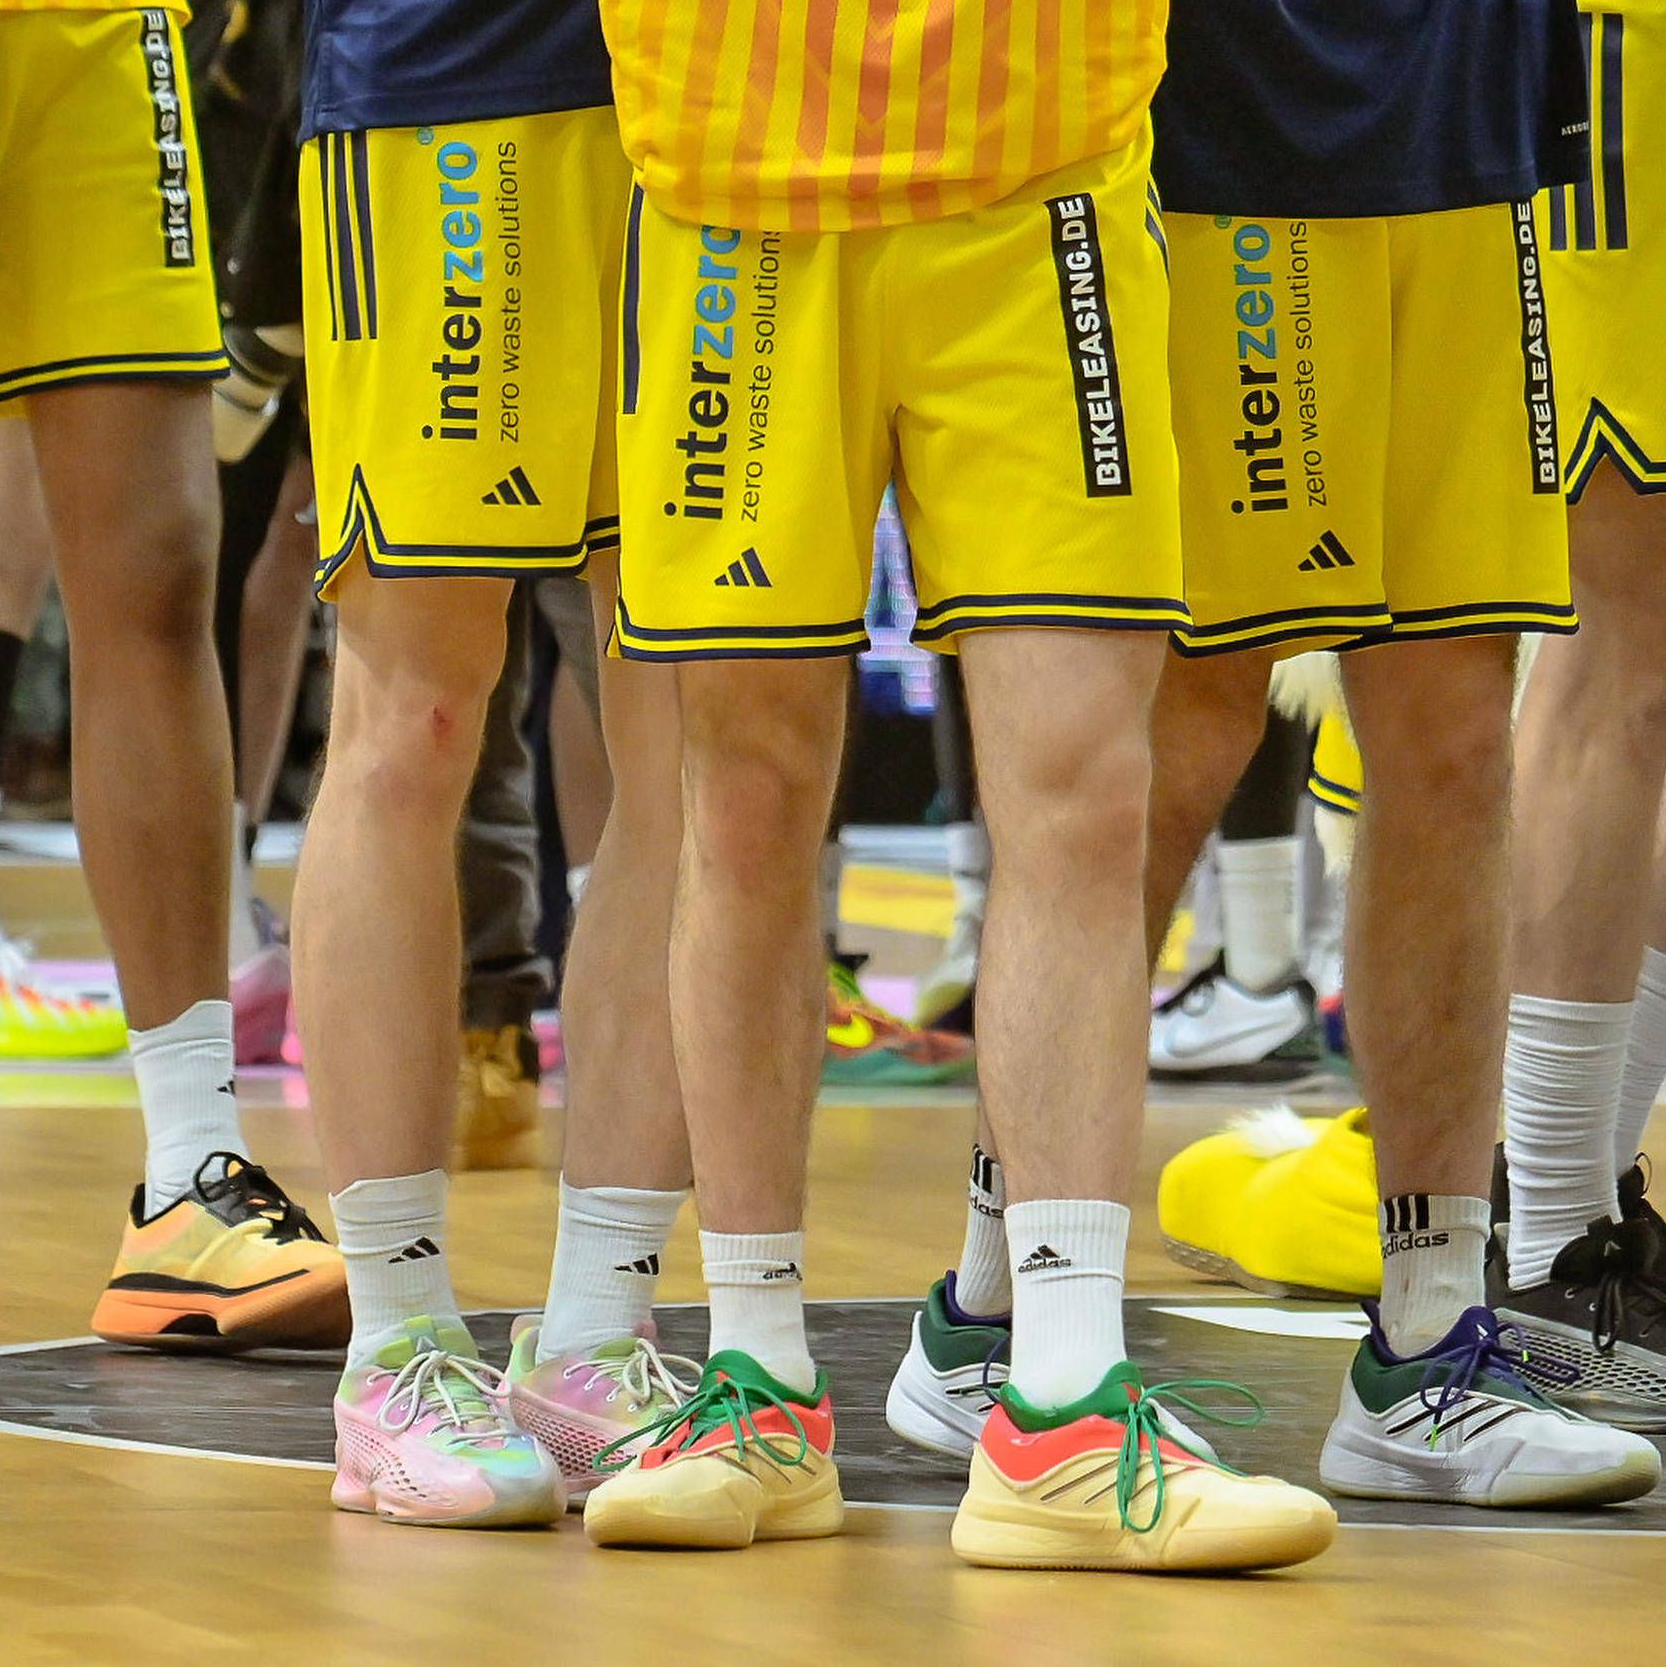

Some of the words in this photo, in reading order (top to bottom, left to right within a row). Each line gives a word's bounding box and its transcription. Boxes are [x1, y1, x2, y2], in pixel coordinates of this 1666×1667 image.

[495, 140, 522, 277] solutions
[421, 141, 484, 441] interzero
[501, 287, 522, 374] waste
[1286, 220, 1313, 350] solutions
[664, 224, 742, 521] interzero
[1057, 196, 1122, 487] BIKELEASING.DE
[1230, 222, 1289, 514] interzero
[1516, 201, 1557, 485] BIKELEASING.DE
[500, 382, 520, 444] zero
[748, 363, 772, 452] waste
[1293, 358, 1318, 442] waste
[740, 459, 763, 523] zero
[1302, 448, 1327, 508] zero
[1018, 1255, 1072, 1274] adidas
